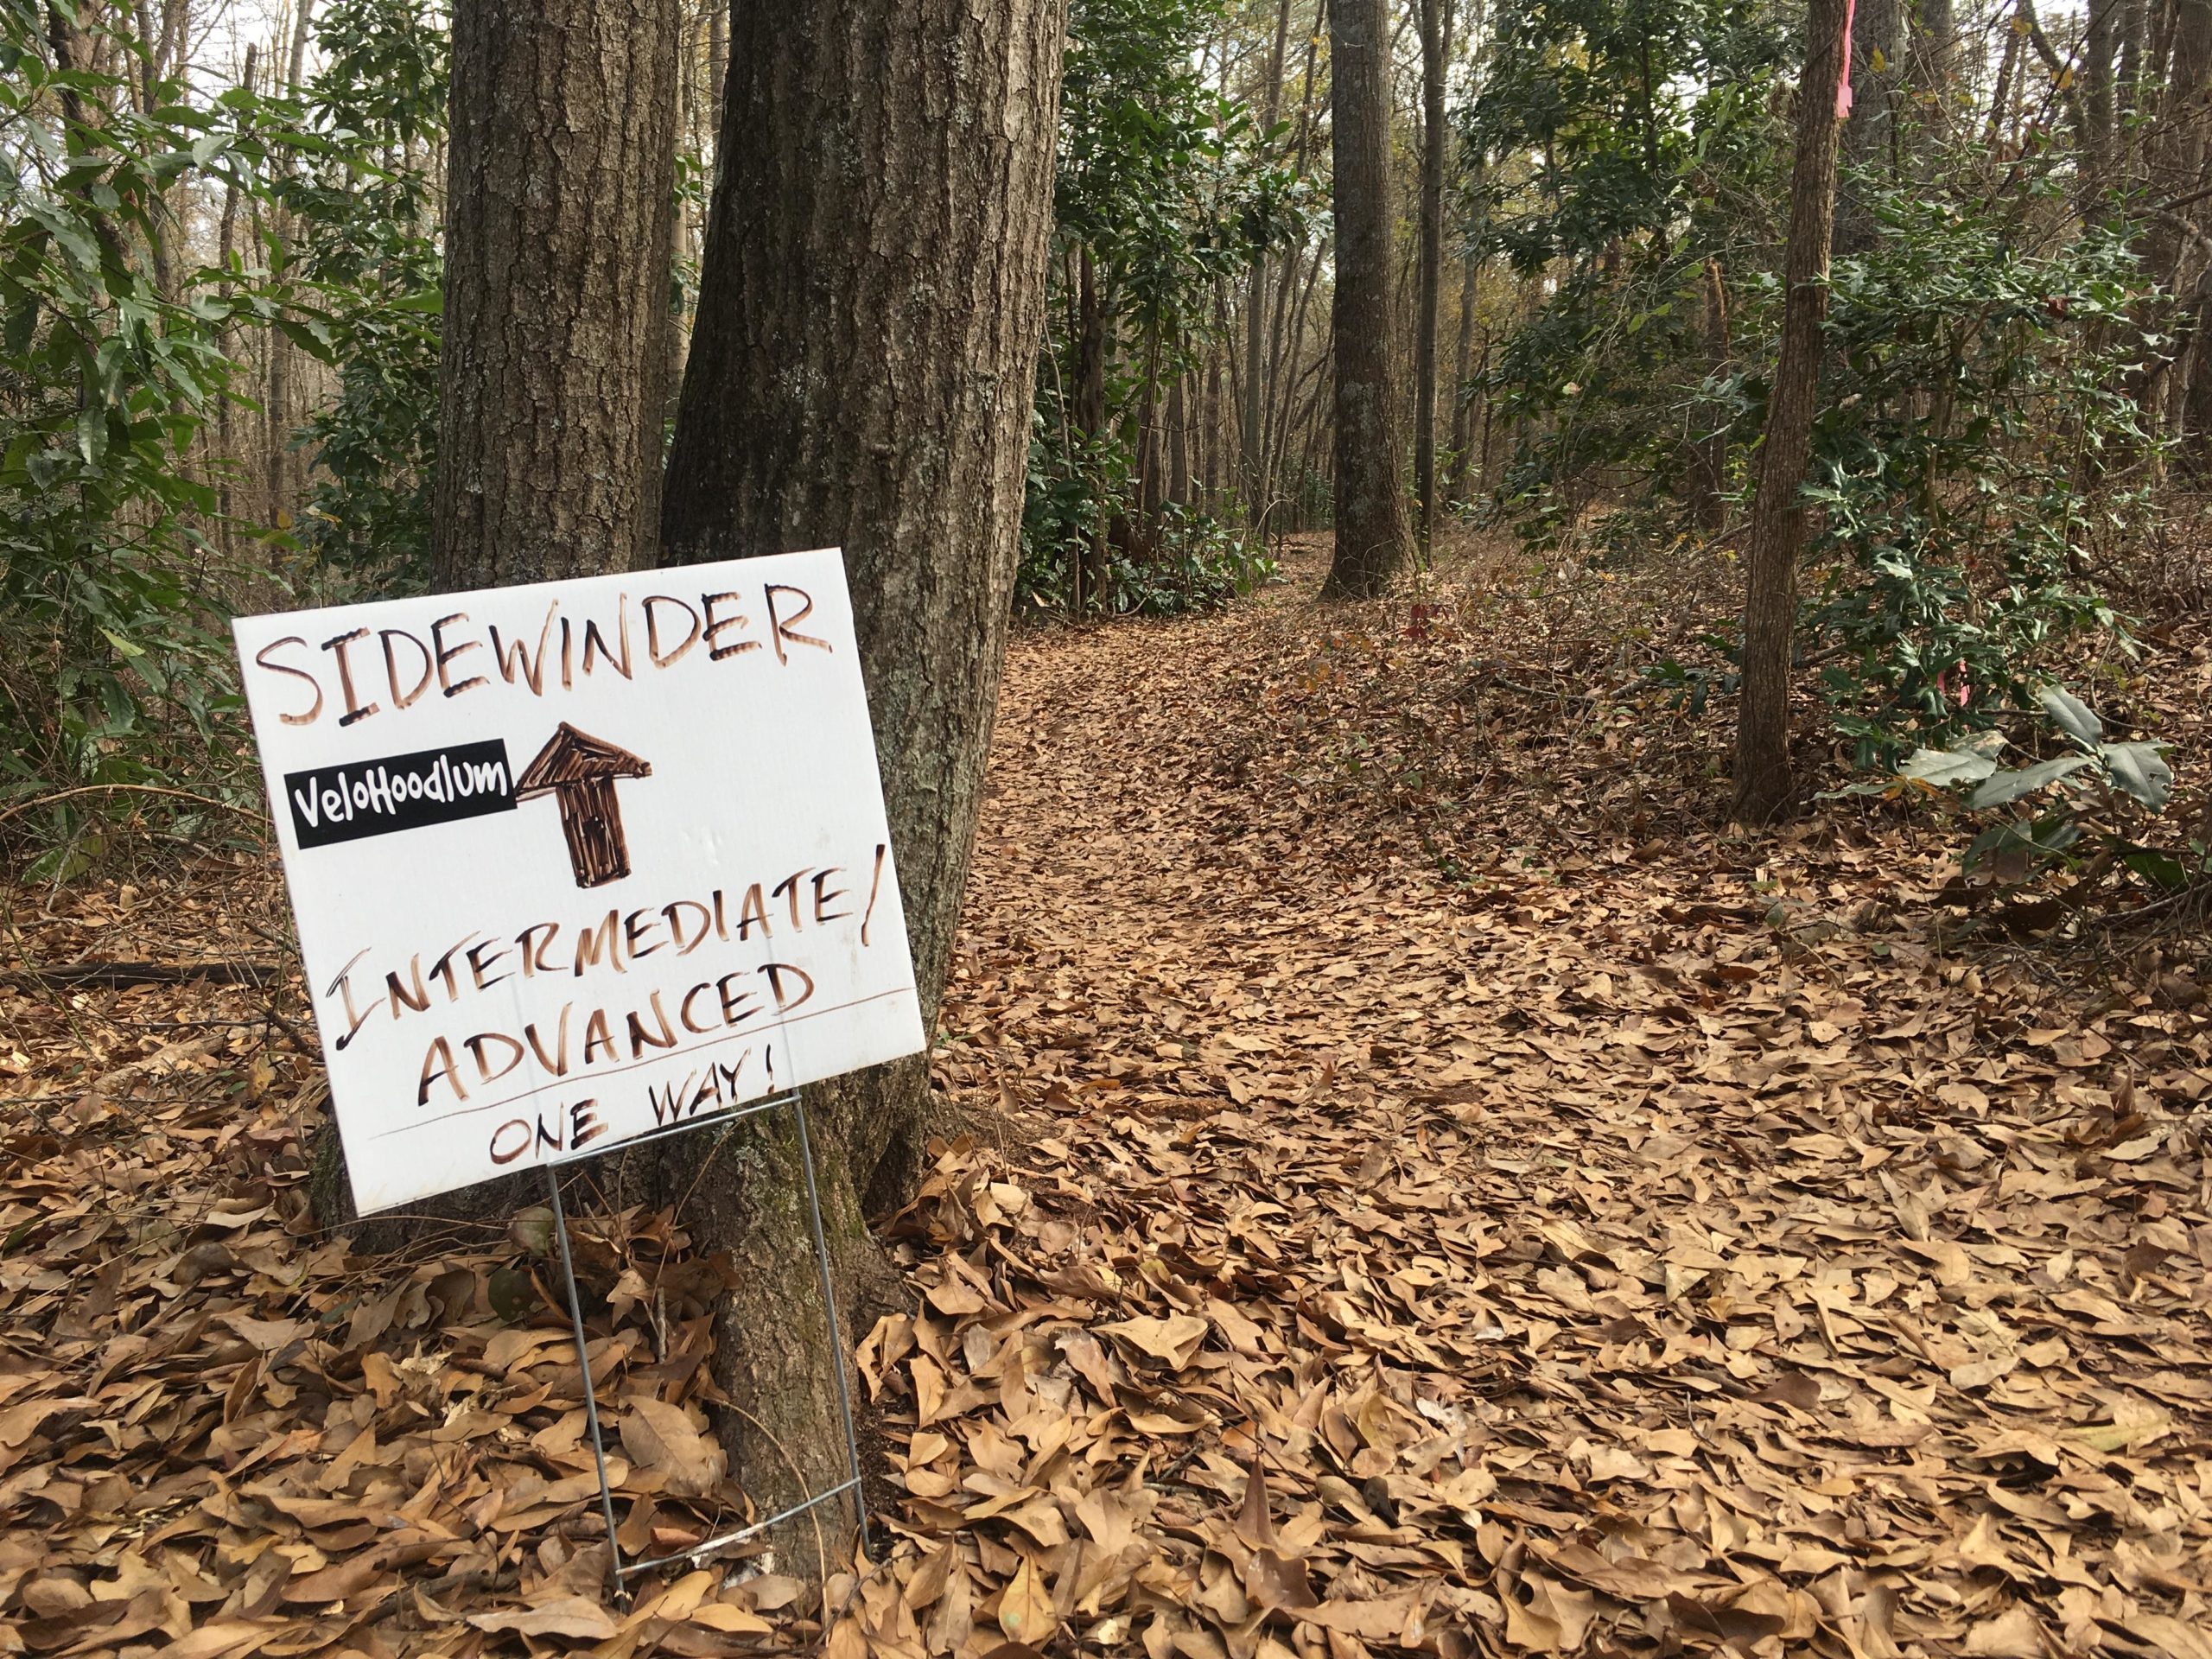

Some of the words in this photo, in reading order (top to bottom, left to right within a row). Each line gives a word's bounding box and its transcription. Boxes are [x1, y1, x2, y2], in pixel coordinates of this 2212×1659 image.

[256, 583, 832, 727] SIDEWINDER
[295, 754, 507, 827] VeloHoodlum
[326, 843, 887, 1051] INTERMEDIATE/
[417, 963, 815, 1107] ADVANCED
[489, 1097, 608, 1165] ONE
[648, 1044, 776, 1127] WAY!
